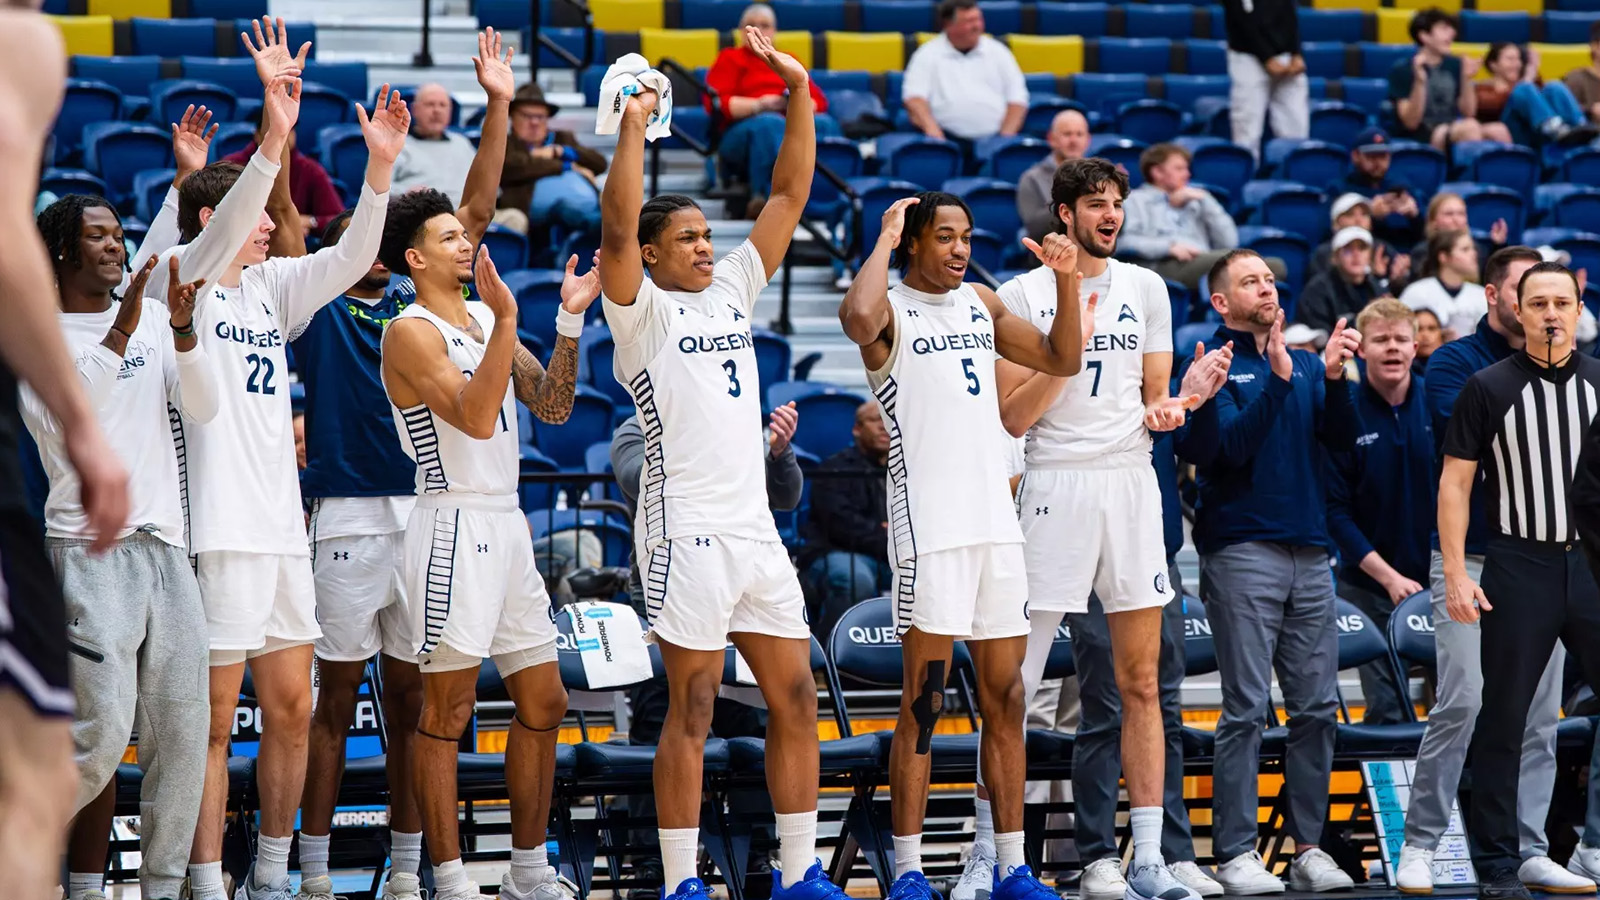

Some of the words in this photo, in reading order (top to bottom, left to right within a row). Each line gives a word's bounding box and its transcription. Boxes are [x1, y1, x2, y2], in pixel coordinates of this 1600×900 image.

[912, 333, 992, 354] QUEENS
[245, 353, 276, 395] 22
[721, 359, 741, 397] 3
[961, 358, 980, 396] 5
[1086, 361, 1102, 397] 7
[597, 620, 612, 662] POWERADE
[848, 626, 902, 644] QUE
